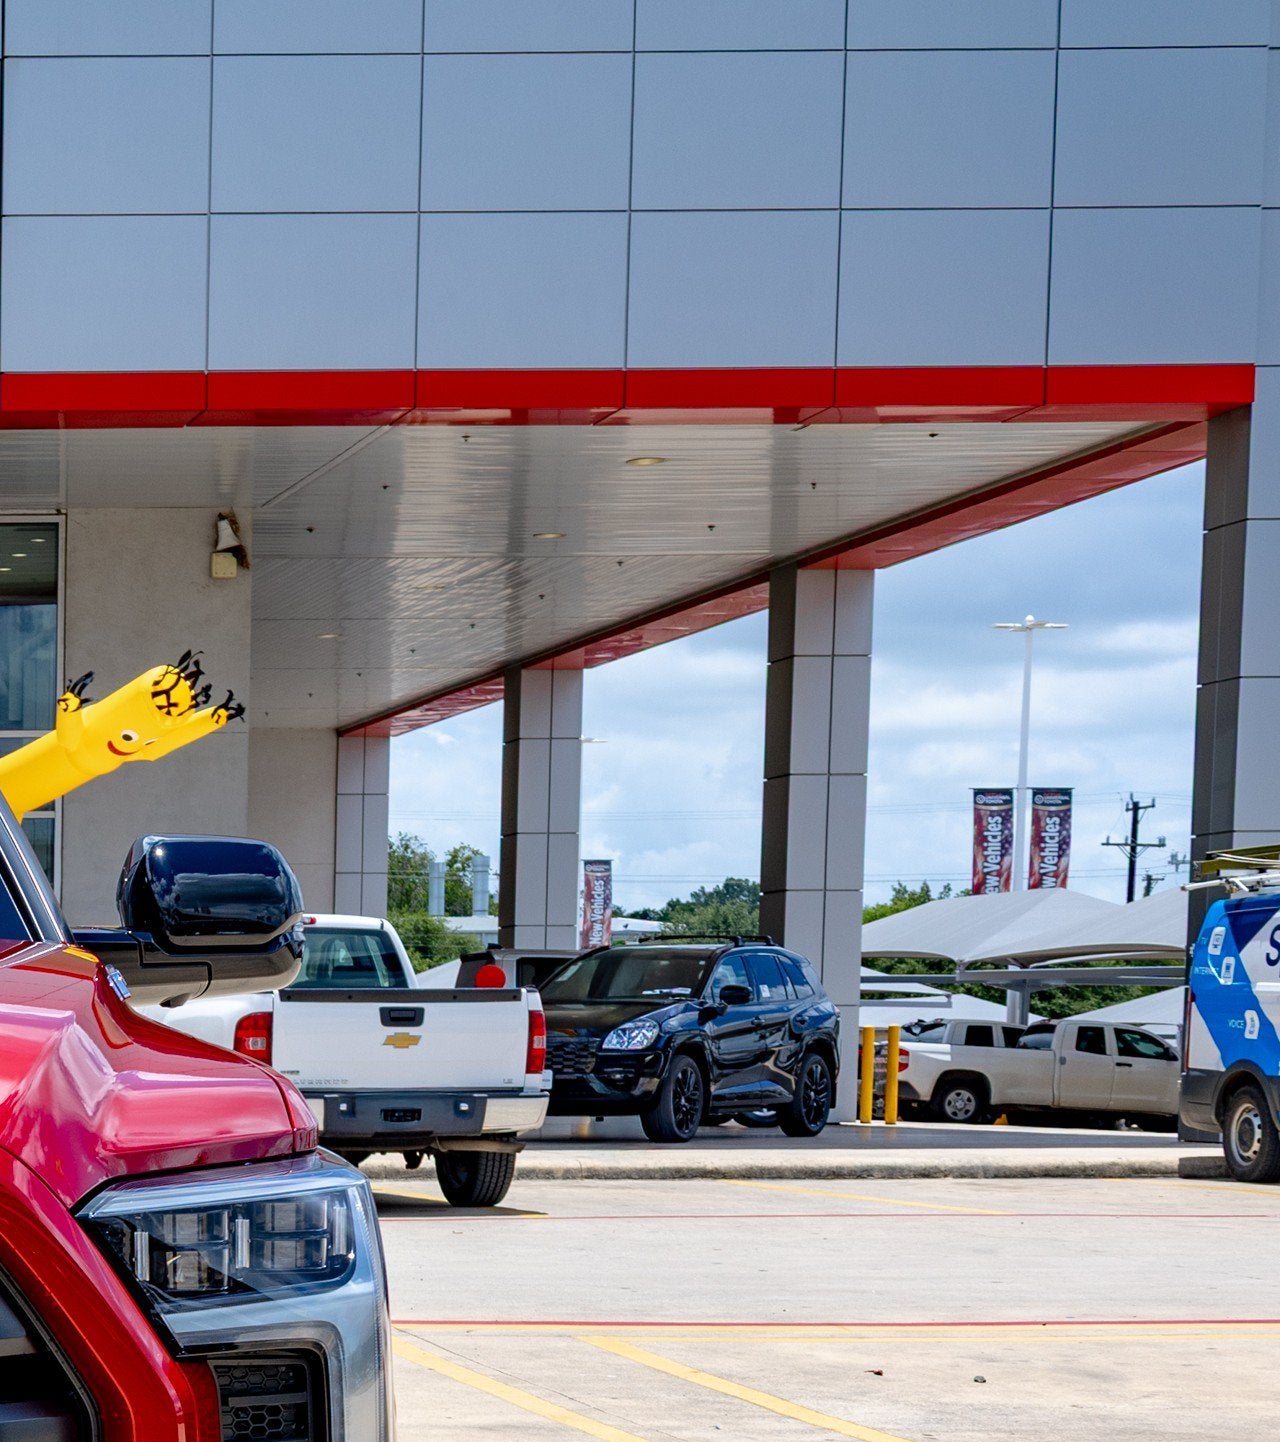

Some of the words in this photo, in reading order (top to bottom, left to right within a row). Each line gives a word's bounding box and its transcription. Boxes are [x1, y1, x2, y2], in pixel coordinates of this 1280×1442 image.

[982, 815, 1003, 873] Vehicles
[1040, 816, 1061, 874] Vehicles
[590, 880, 605, 921] Vehicles
[589, 923, 604, 945] New
